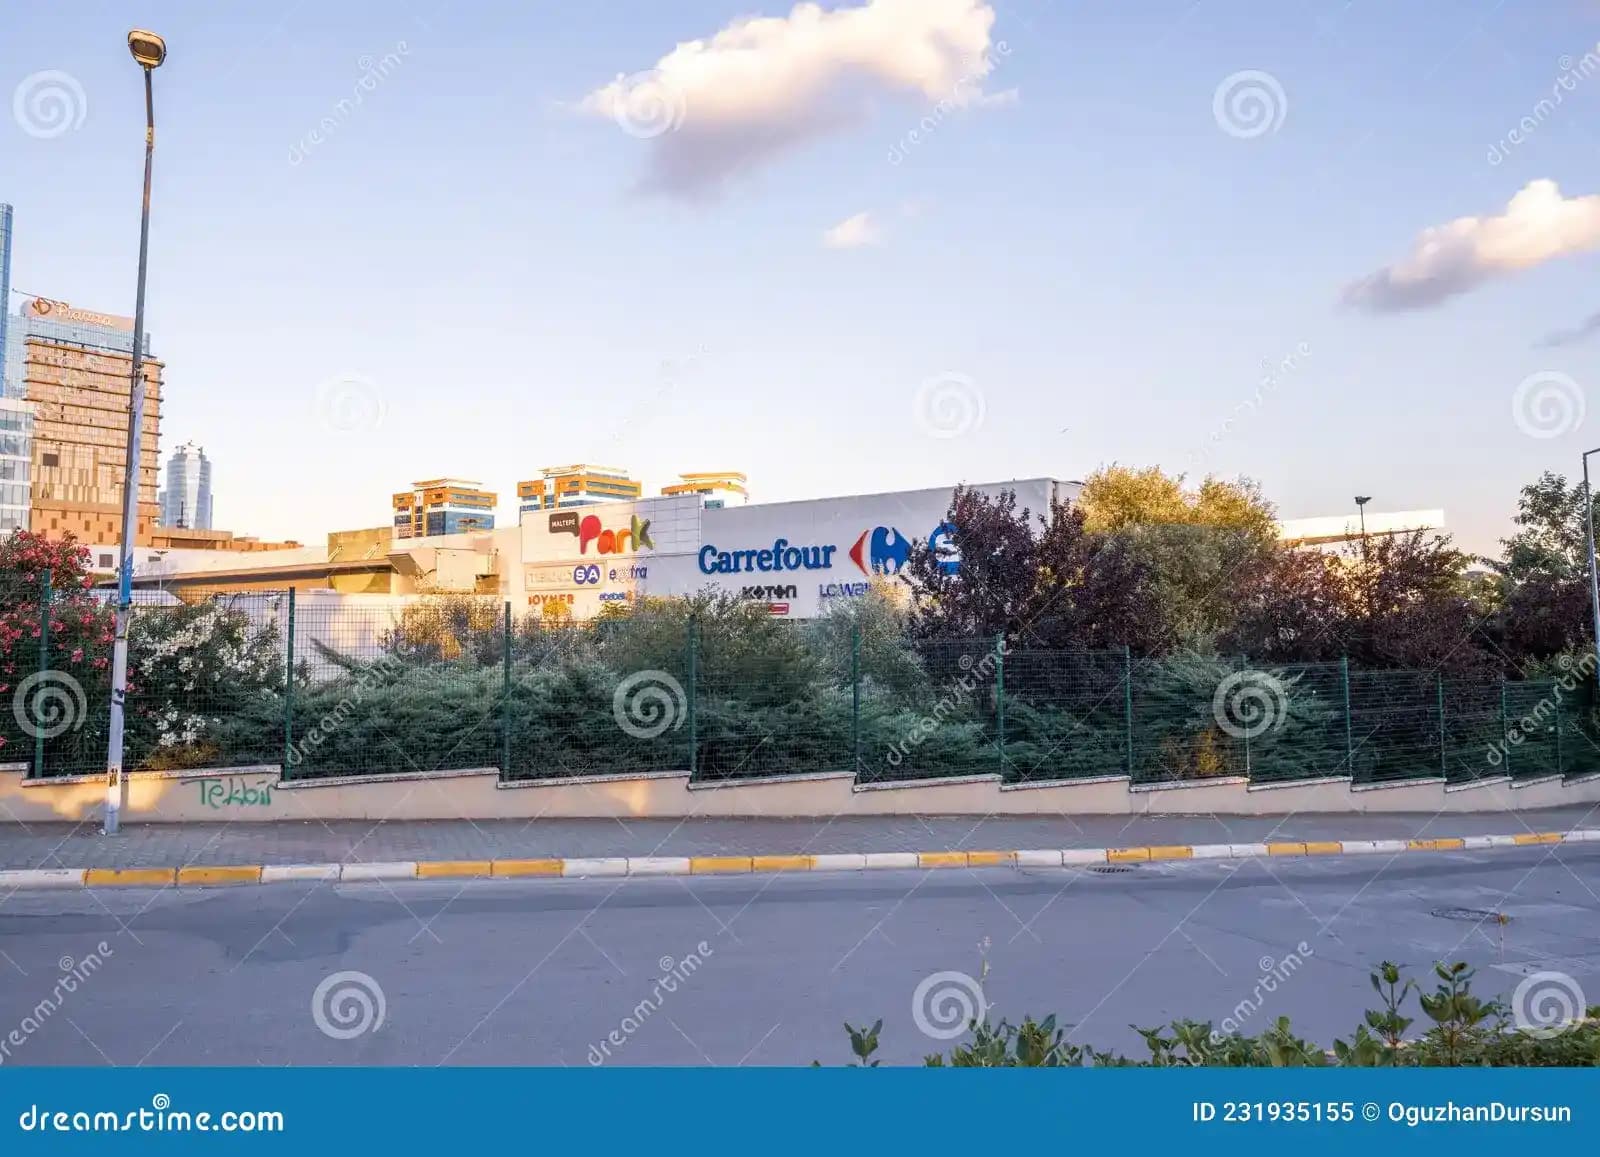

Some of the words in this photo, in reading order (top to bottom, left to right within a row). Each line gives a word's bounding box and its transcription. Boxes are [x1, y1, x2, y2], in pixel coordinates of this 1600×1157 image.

[551, 518, 576, 528] MALTEPE
[579, 514, 656, 555] Park
[698, 538, 836, 575] Carrefour
